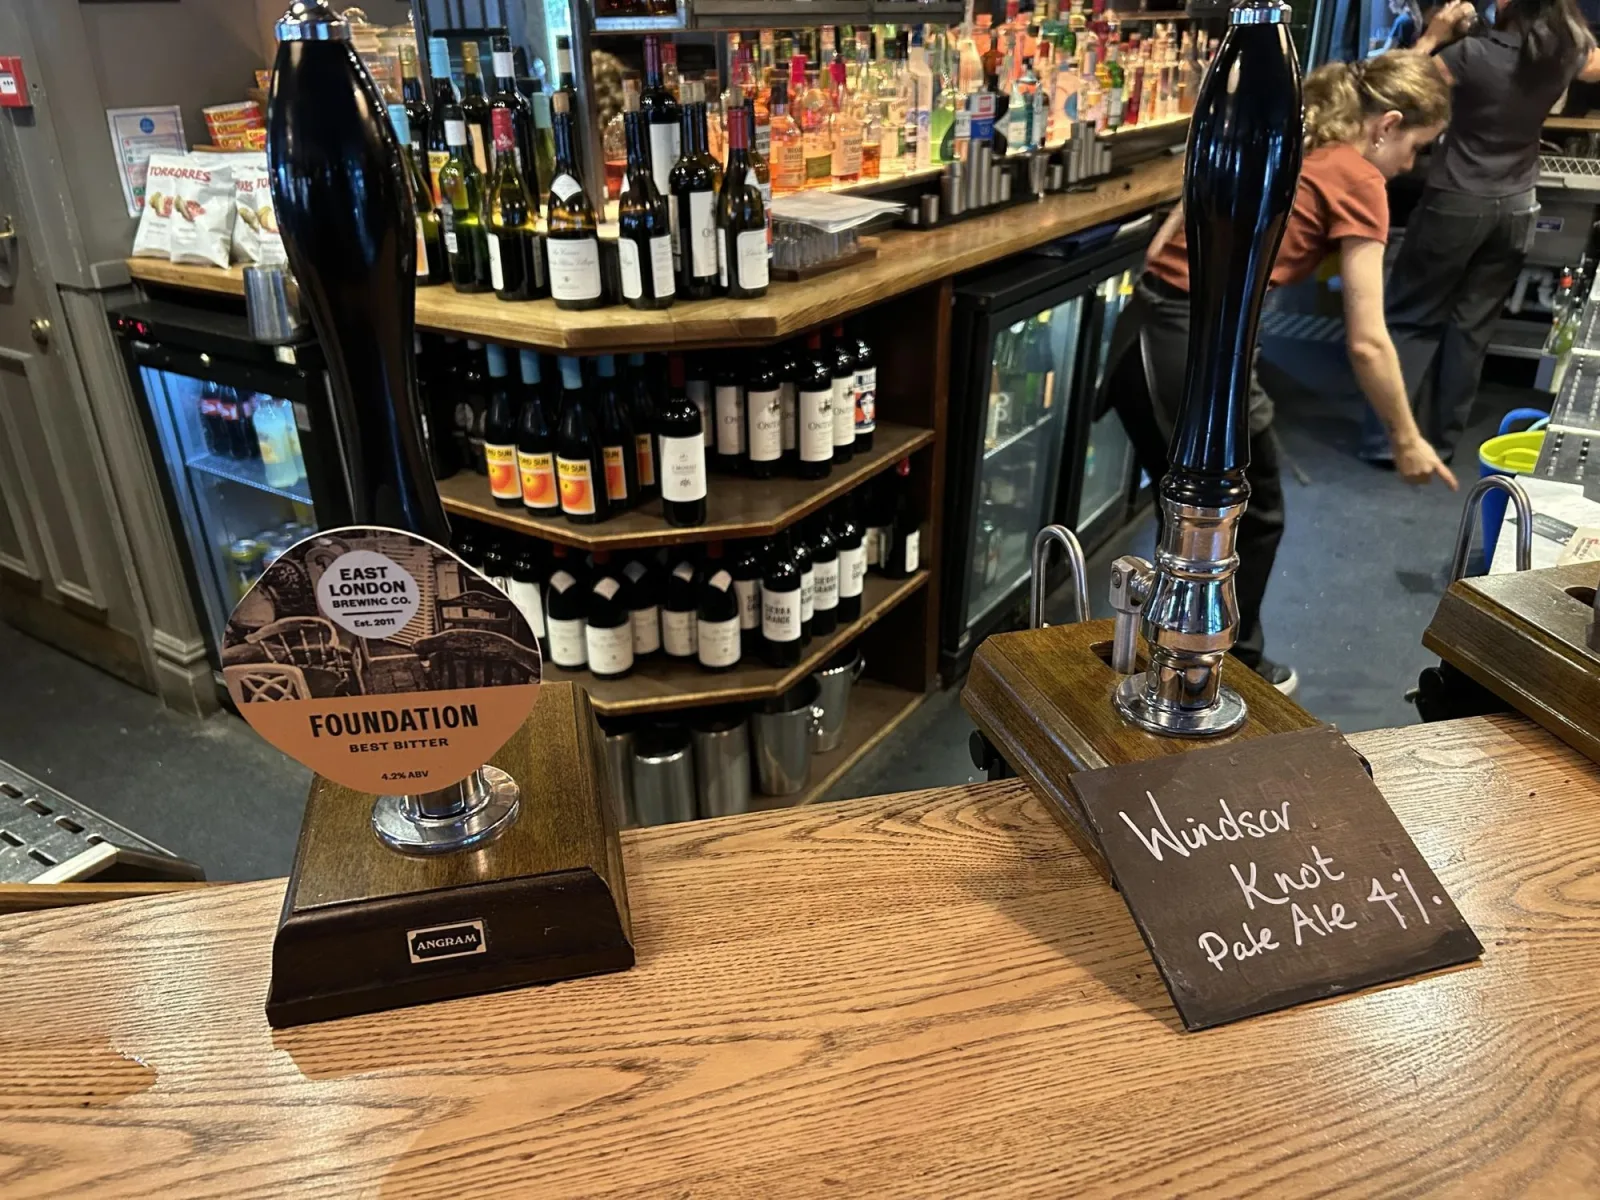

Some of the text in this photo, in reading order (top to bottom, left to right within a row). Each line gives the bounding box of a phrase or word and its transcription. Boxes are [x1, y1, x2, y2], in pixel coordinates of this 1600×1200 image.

[339, 566, 388, 581] EAST
[328, 580, 406, 597] LONDON
[332, 596, 411, 608] BREWING CO.
[353, 618, 396, 628] Est. 2011
[309, 703, 479, 737] FOUNDATION
[349, 737, 449, 753] BEST BITTER
[381, 770, 429, 781] 4.2% ABV
[1118, 790, 1291, 862] Windsor
[1229, 845, 1345, 910] Knot
[416, 933, 478, 951] ANGRAM
[1198, 922, 1280, 972] Pale
[1290, 901, 1358, 946] Ale
